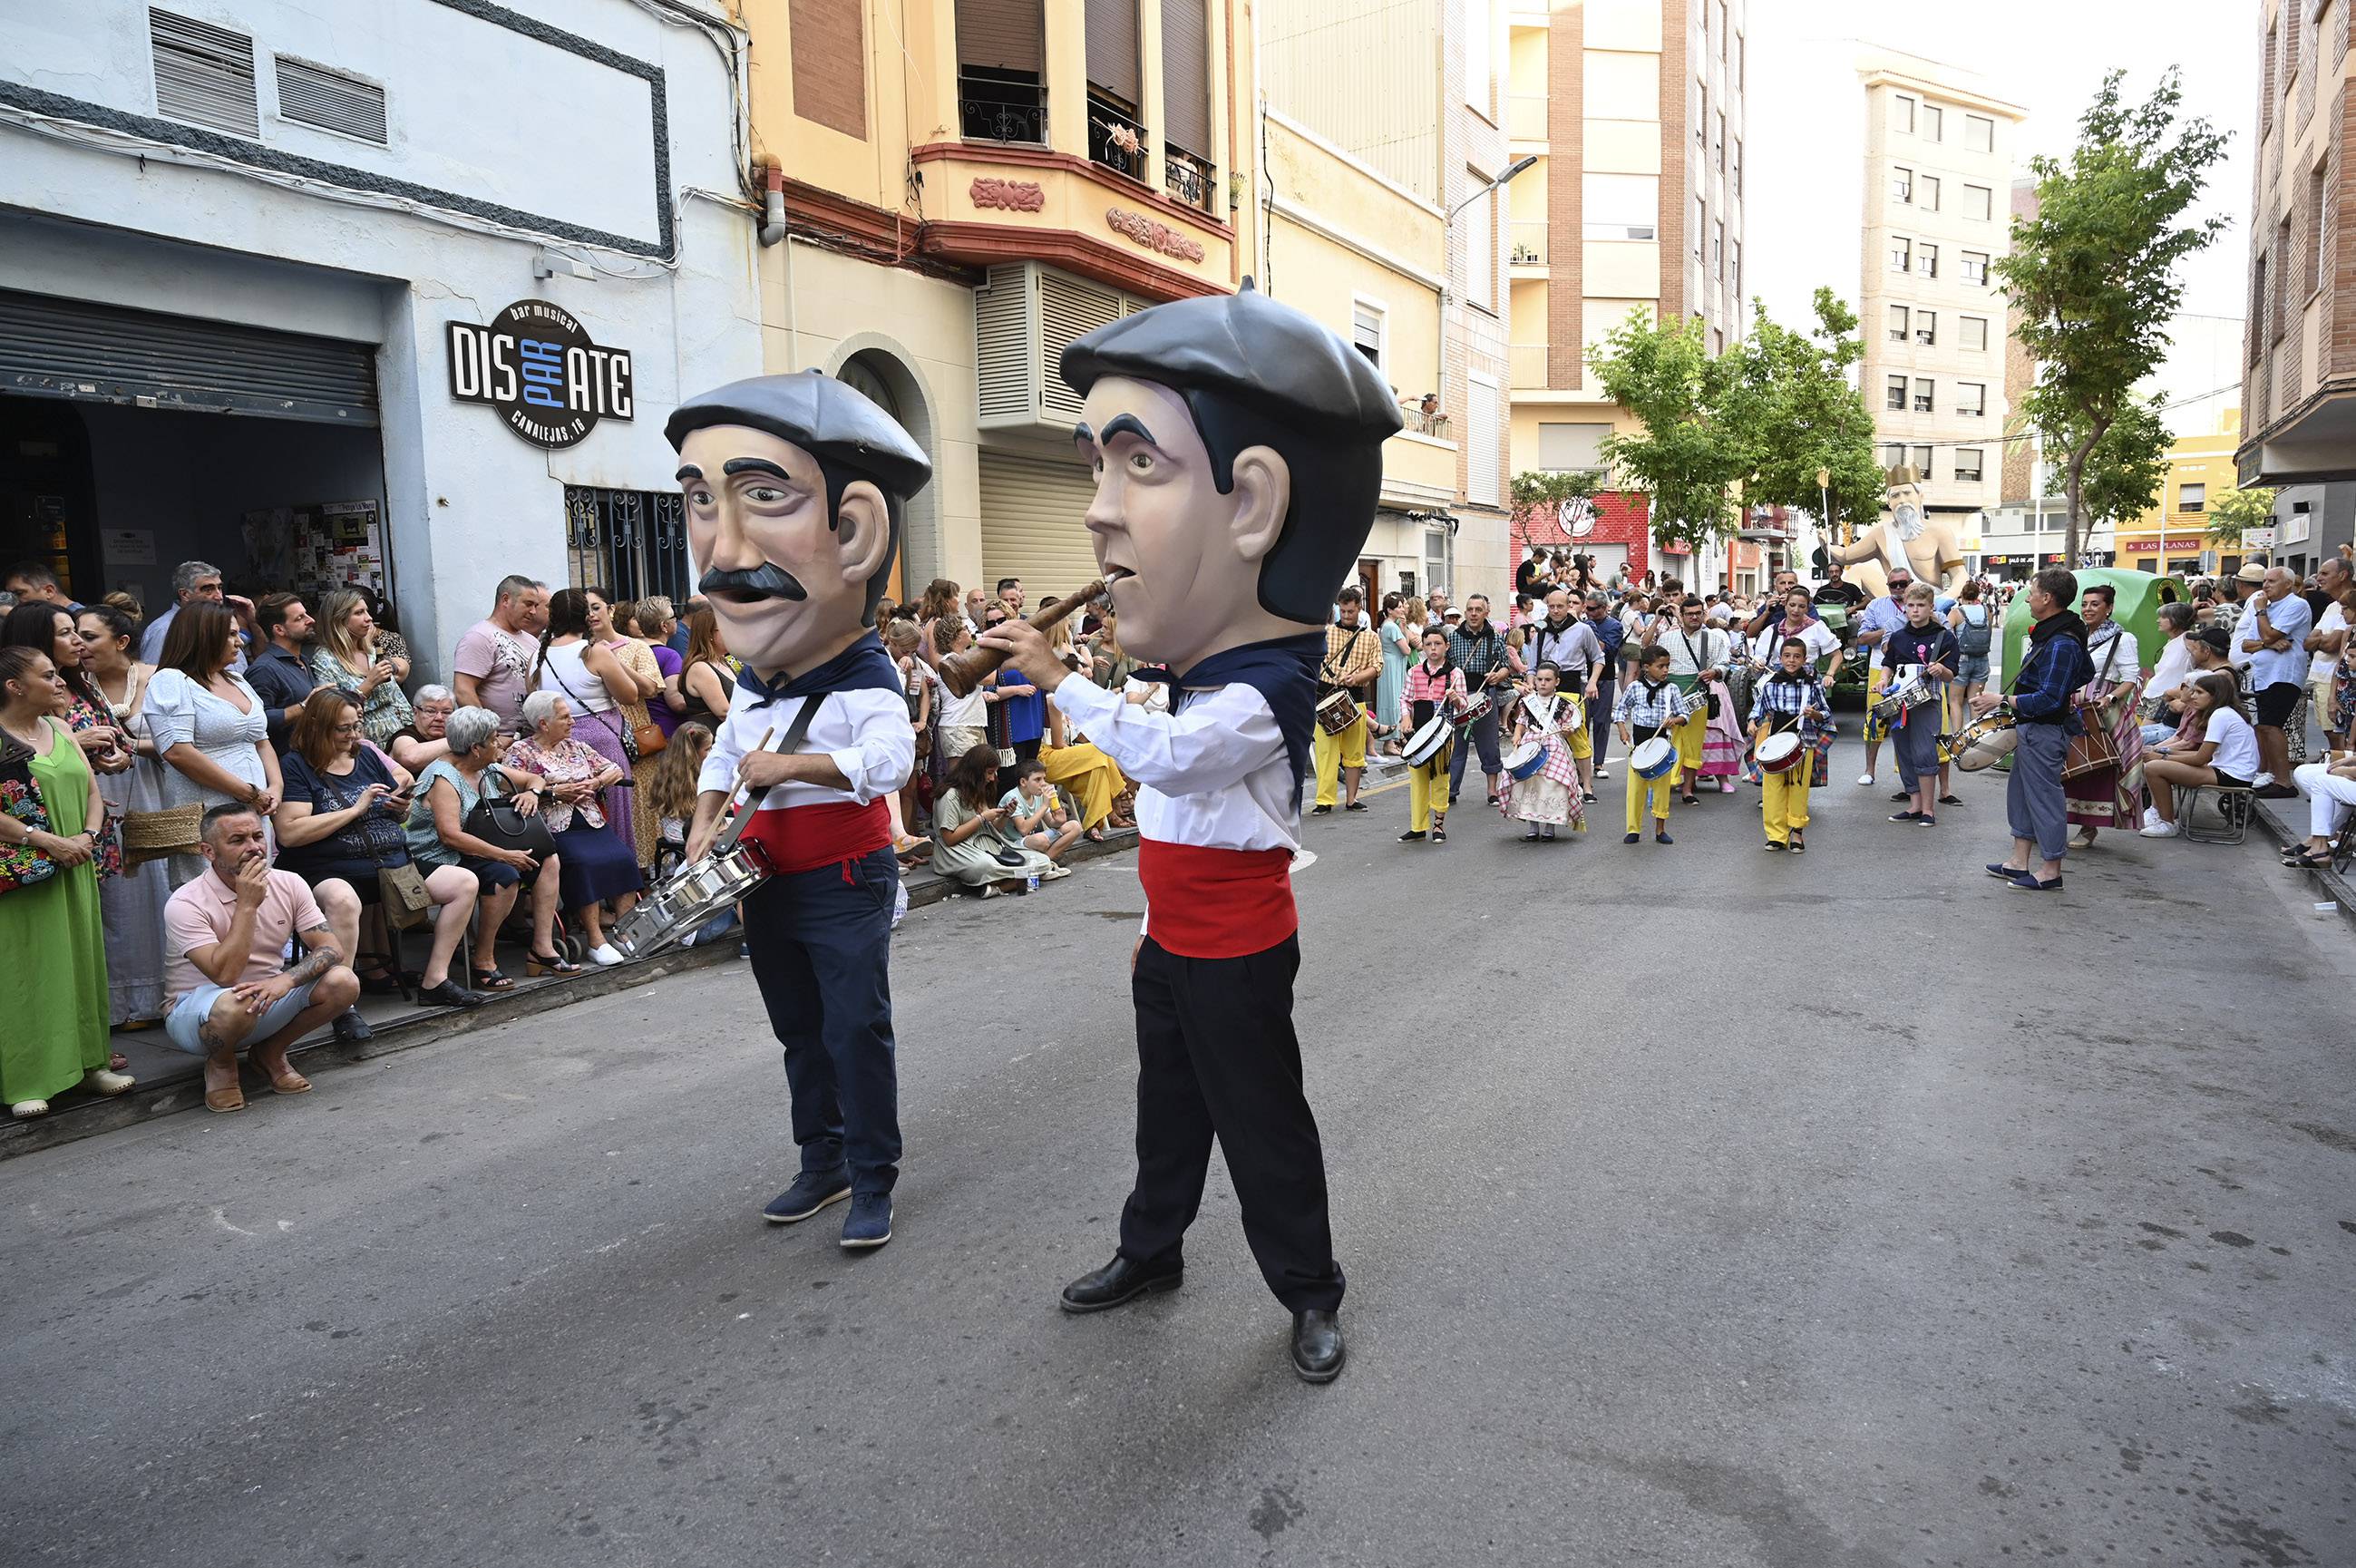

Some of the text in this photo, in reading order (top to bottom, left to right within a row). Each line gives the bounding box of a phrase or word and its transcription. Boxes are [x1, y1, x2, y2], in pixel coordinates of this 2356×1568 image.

[510, 305, 578, 333] bar musical
[511, 410, 586, 442] CANALEJAS, 16
